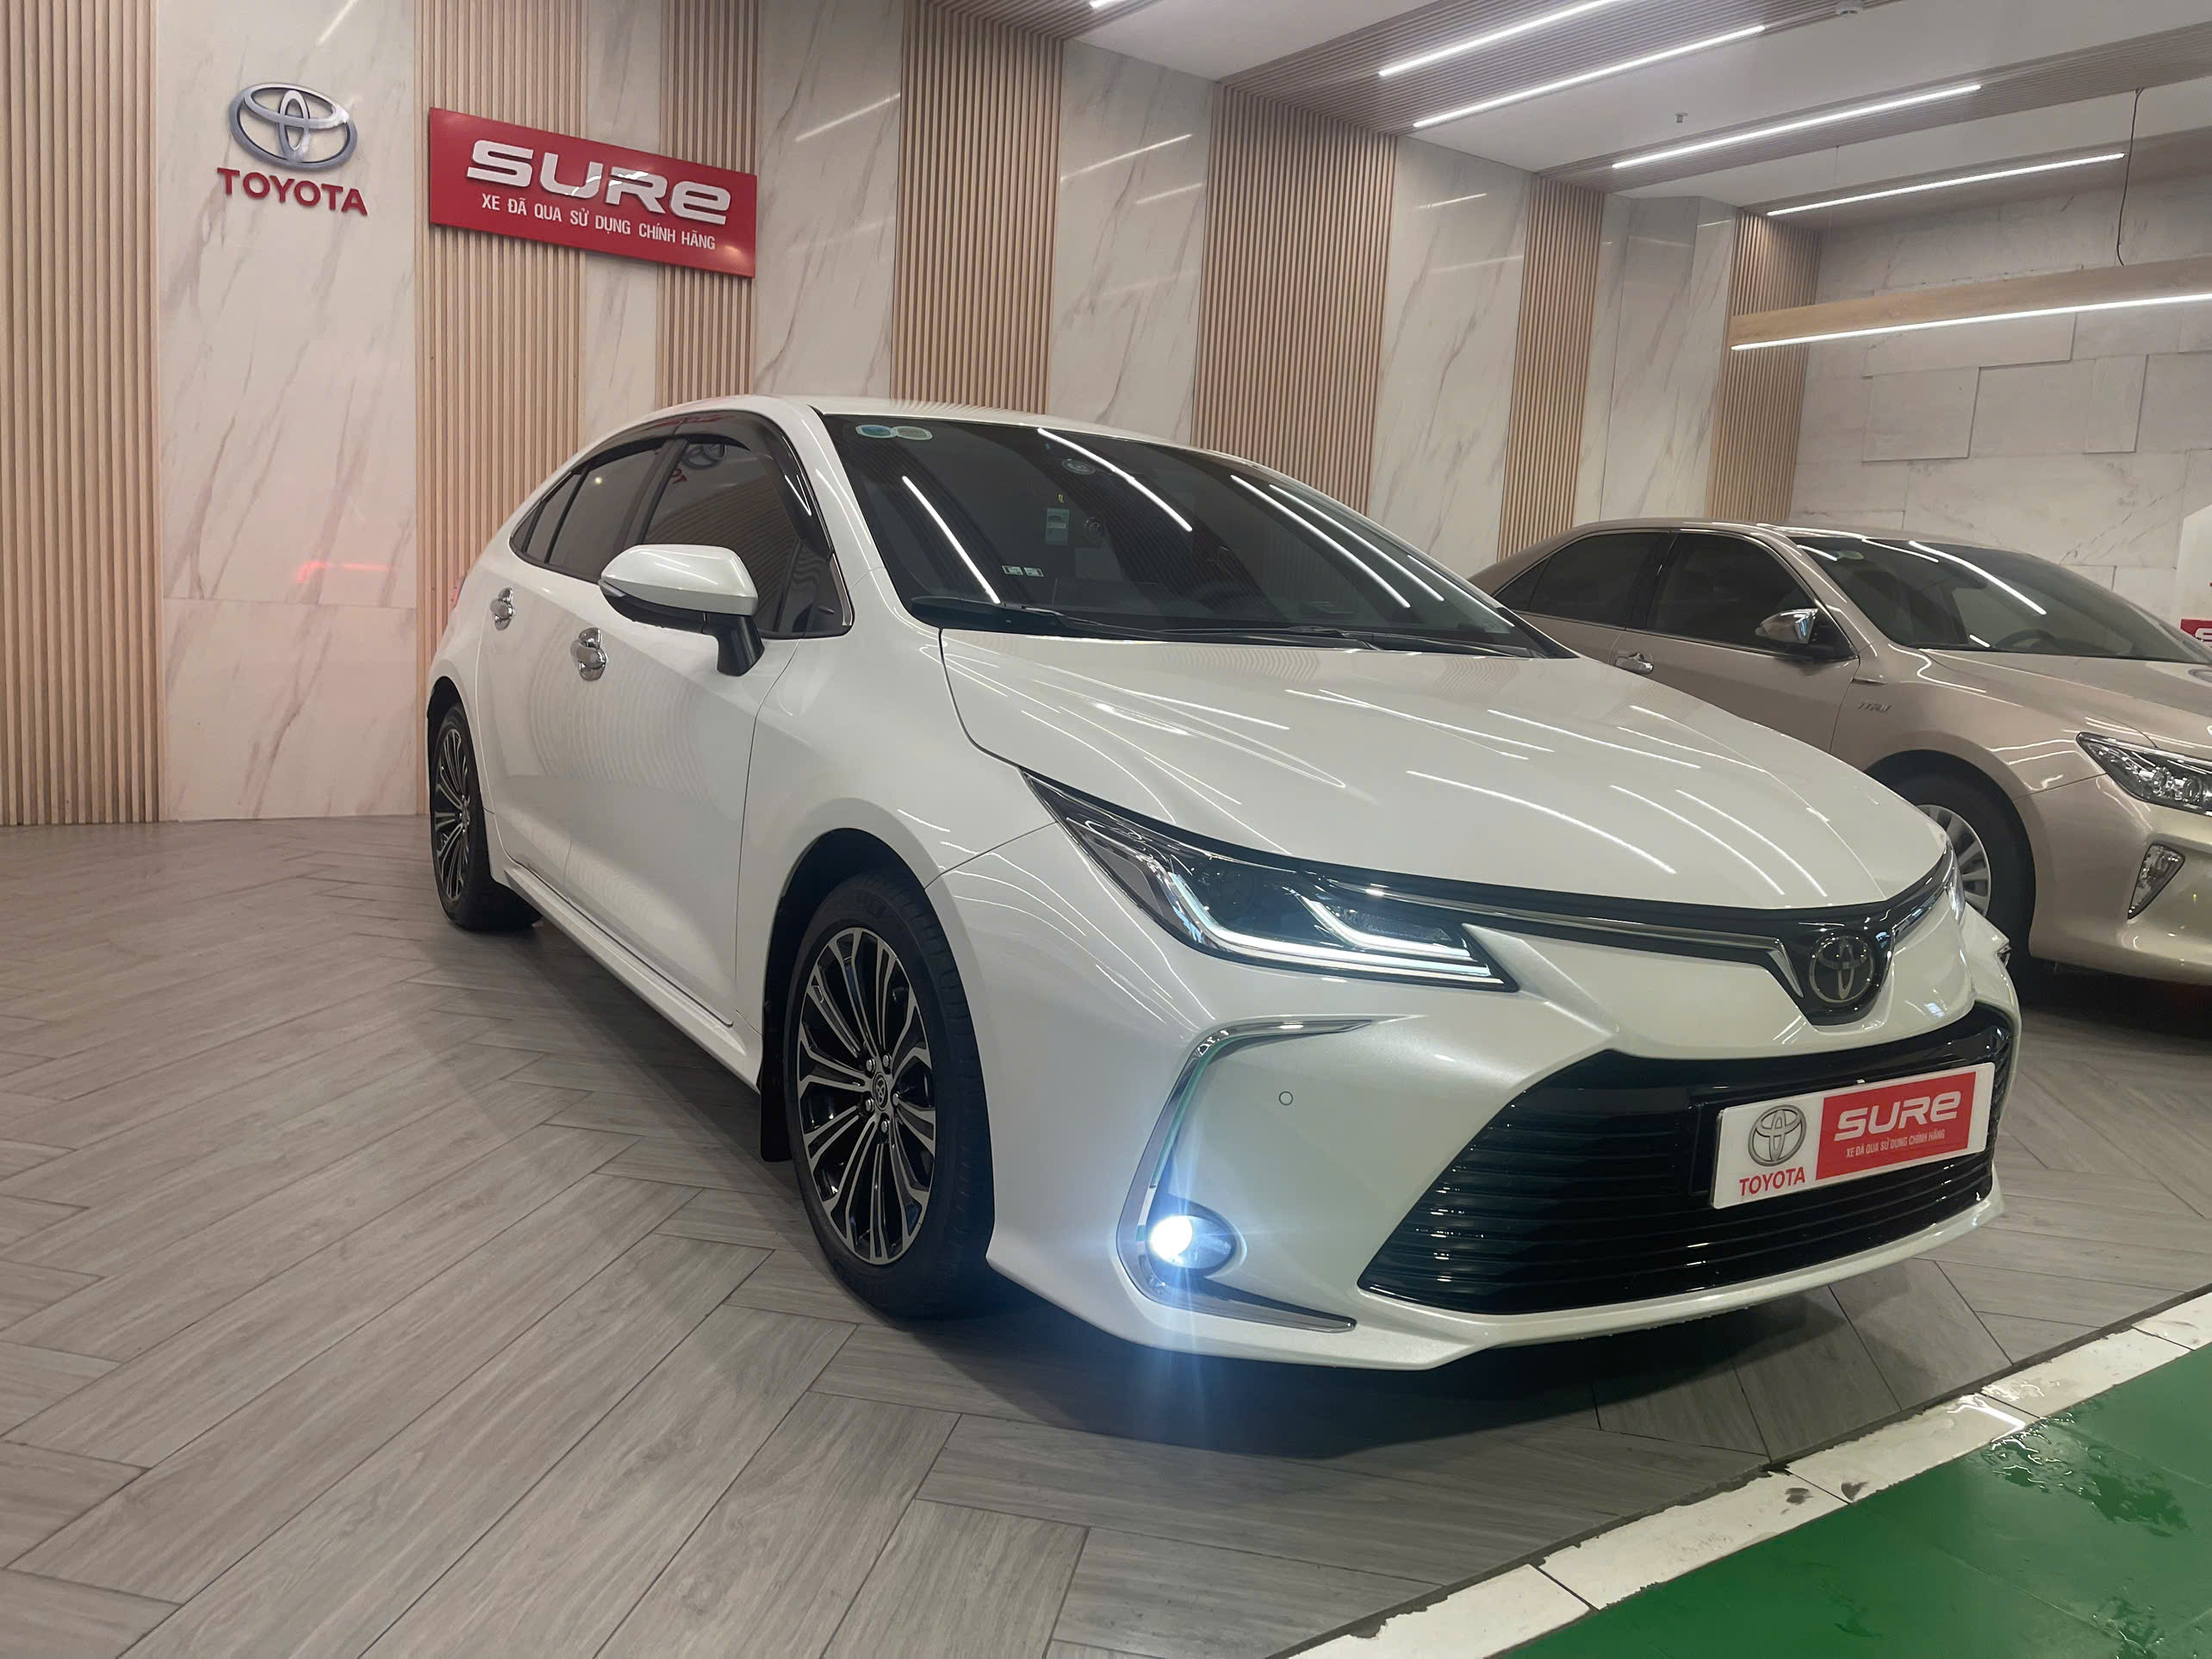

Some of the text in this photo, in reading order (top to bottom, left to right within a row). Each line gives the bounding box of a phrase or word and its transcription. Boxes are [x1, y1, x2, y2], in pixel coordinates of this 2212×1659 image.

[217, 167, 368, 216] TOYOTA
[482, 192, 716, 250] XE ĐÃ QUA SỬ DỤNG CHÍNH HÃNG
[1846, 1148, 1855, 1158] XE
[1866, 1142, 1880, 1154] QUA
[1739, 1167, 1805, 1196] TOYOTA
